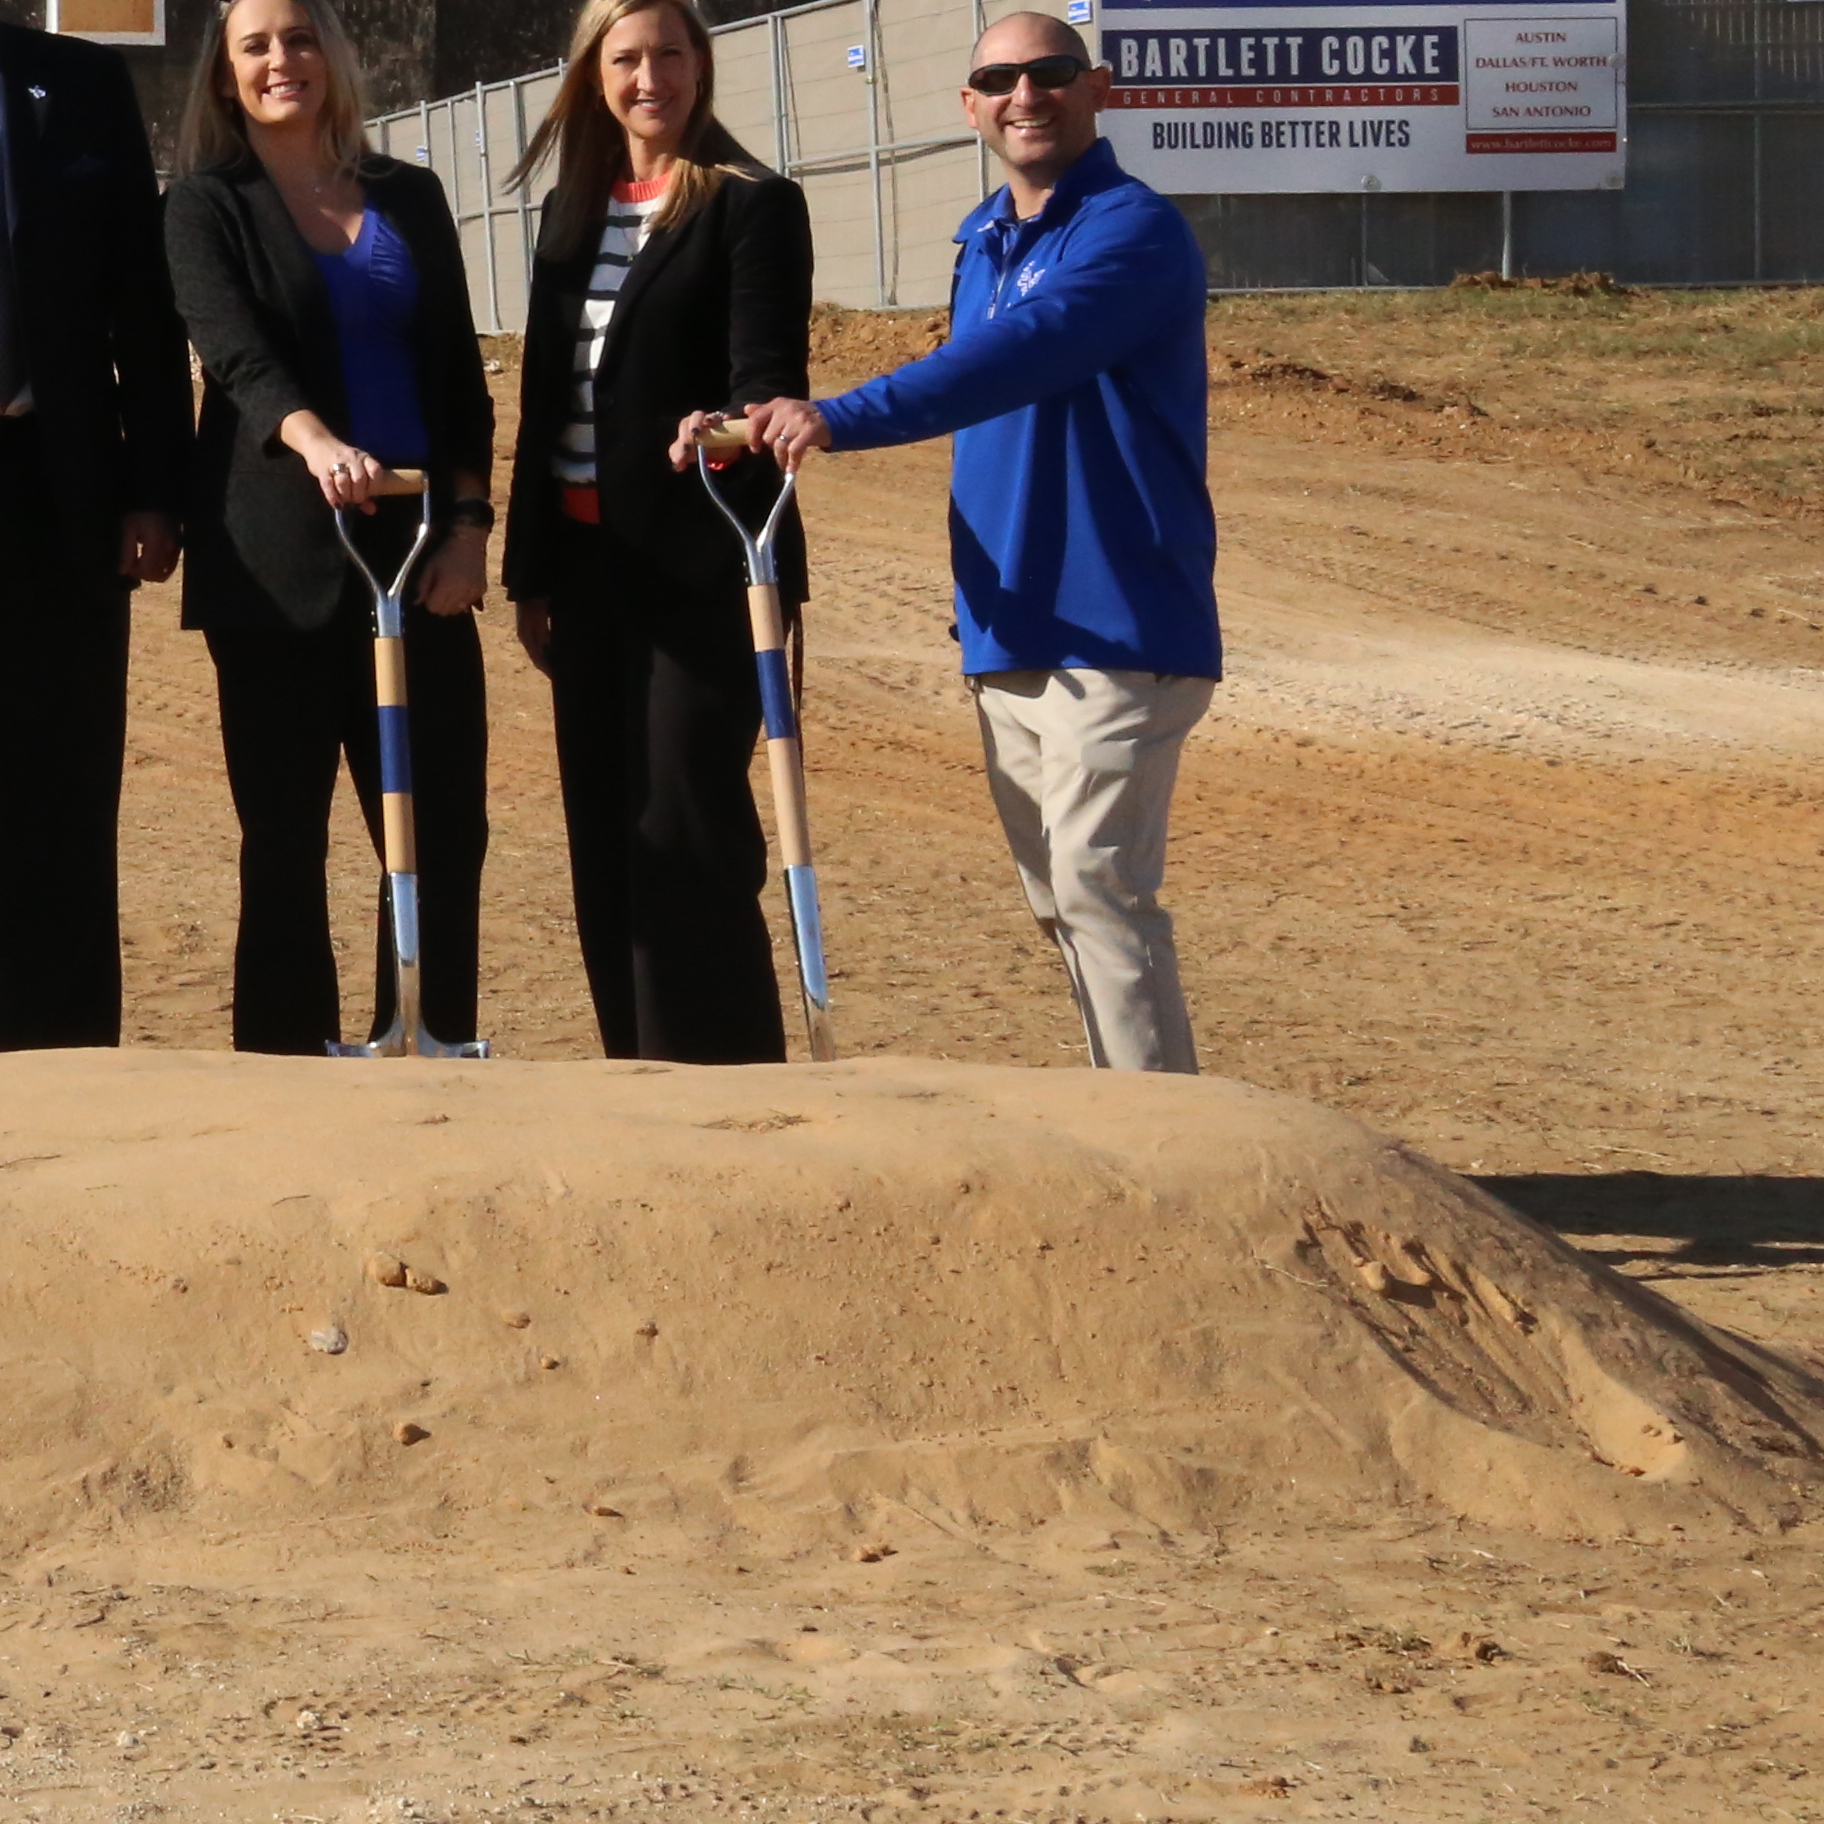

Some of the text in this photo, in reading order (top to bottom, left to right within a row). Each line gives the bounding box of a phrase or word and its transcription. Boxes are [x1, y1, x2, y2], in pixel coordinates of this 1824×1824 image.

[1515, 32, 1566, 43] AUSTIN
[1120, 35, 1440, 77] BARTLETT COCKE
[1475, 56, 1607, 68] DALLAS/FT. WORTH
[1505, 81, 1578, 93] HOUSTON
[1123, 88, 1439, 105] GENERAL CONTRACTORS
[1492, 105, 1591, 118] SAN ANTONIO
[1152, 119, 1410, 149] BUILDING BETTER LIVES
